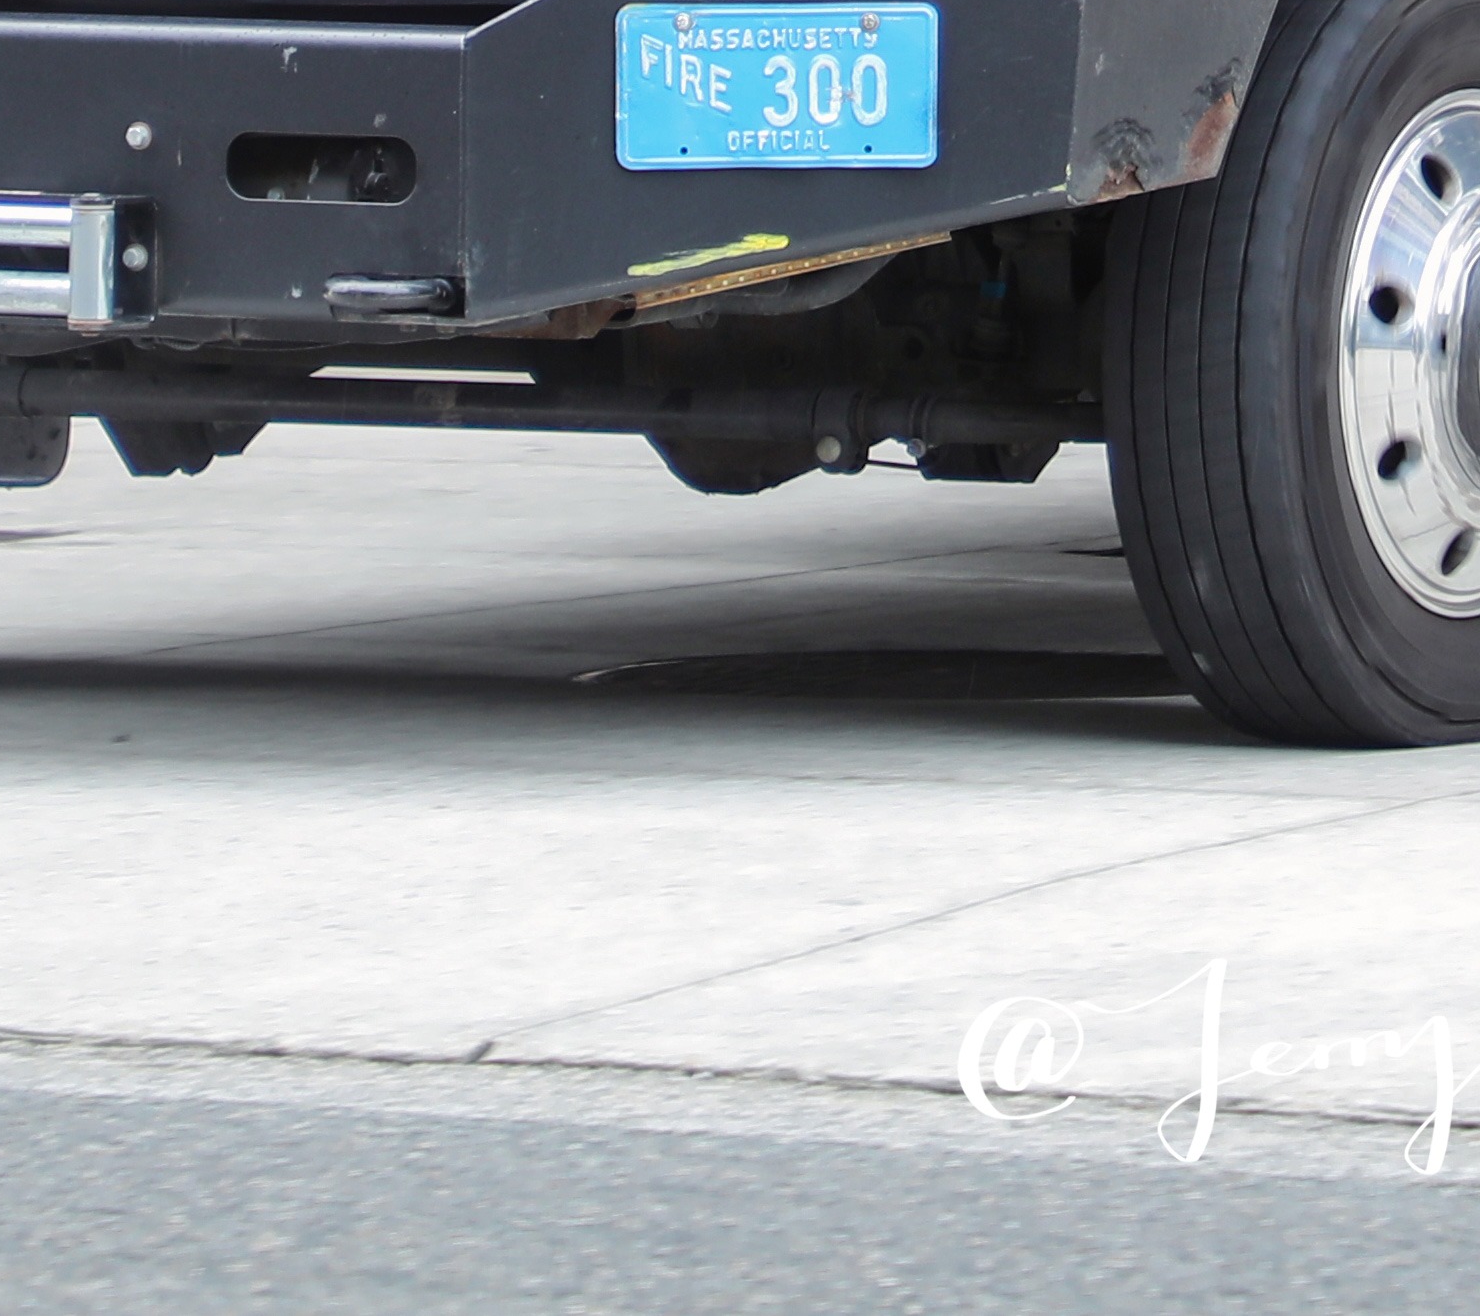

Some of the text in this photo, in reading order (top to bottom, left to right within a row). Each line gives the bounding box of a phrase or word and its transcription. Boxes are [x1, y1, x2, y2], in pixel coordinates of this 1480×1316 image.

[638, 32, 888, 127] FIRE 300
[726, 129, 830, 152] OFFICIAL
